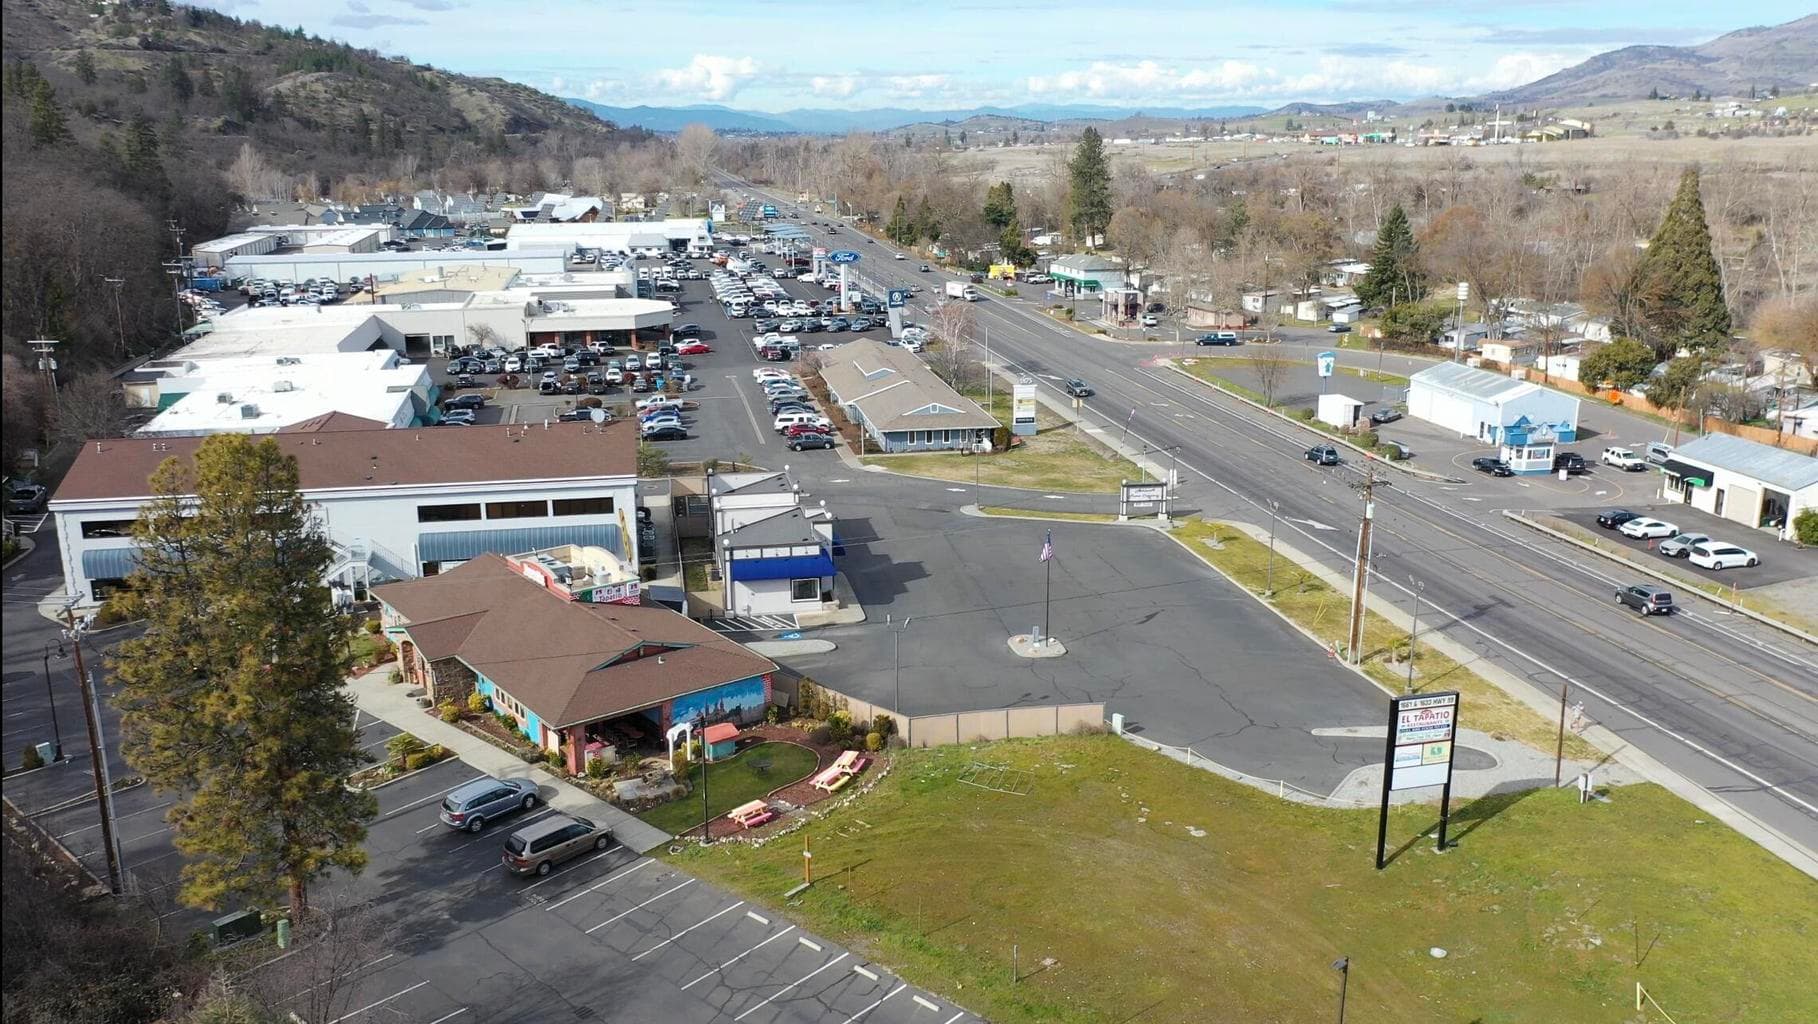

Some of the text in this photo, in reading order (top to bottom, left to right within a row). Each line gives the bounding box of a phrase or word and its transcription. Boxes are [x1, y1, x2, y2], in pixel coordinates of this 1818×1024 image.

[1433, 697, 1446, 705] HWY
[1402, 711, 1450, 723] EL TAPATIO
